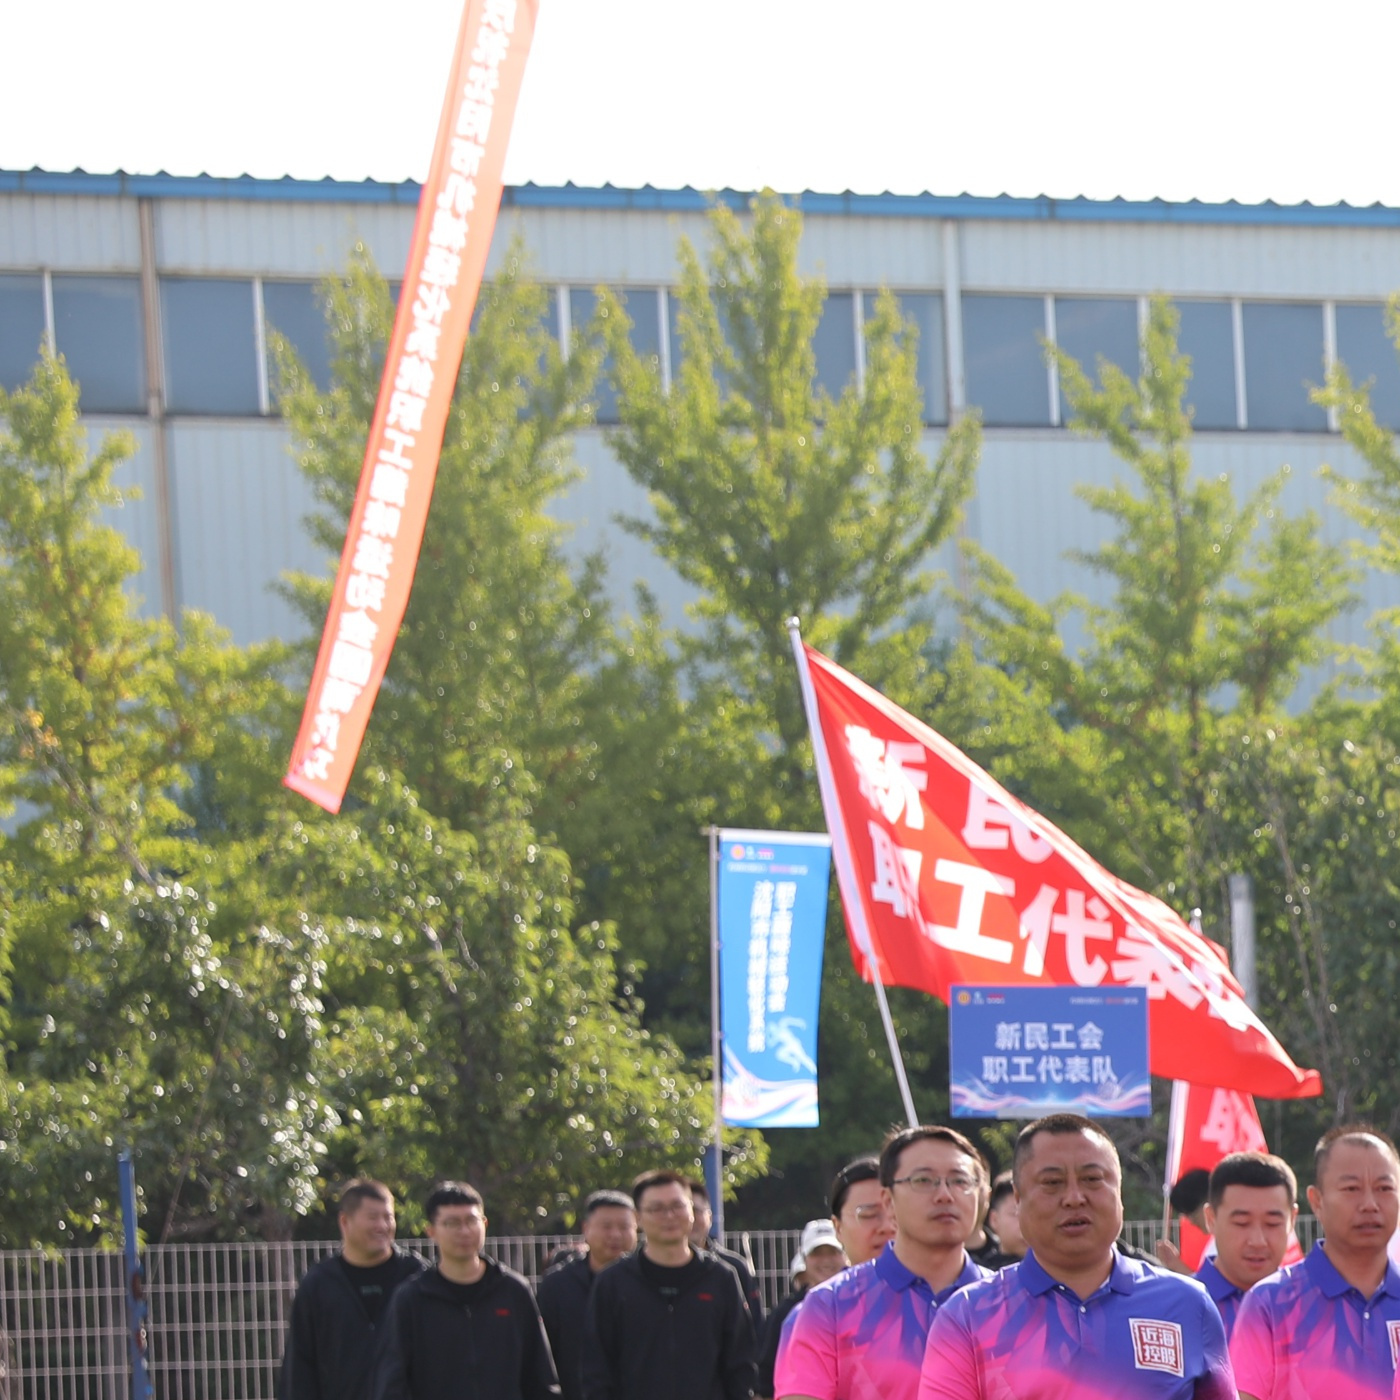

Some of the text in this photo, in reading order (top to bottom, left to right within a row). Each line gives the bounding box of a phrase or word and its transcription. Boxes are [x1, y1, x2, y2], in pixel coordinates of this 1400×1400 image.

[995, 1021, 1104, 1051] 新民工会
[982, 1055, 1118, 1084] 职工代表队
[1140, 1326, 1175, 1347] 近海
[1143, 1344, 1177, 1367] 控股
